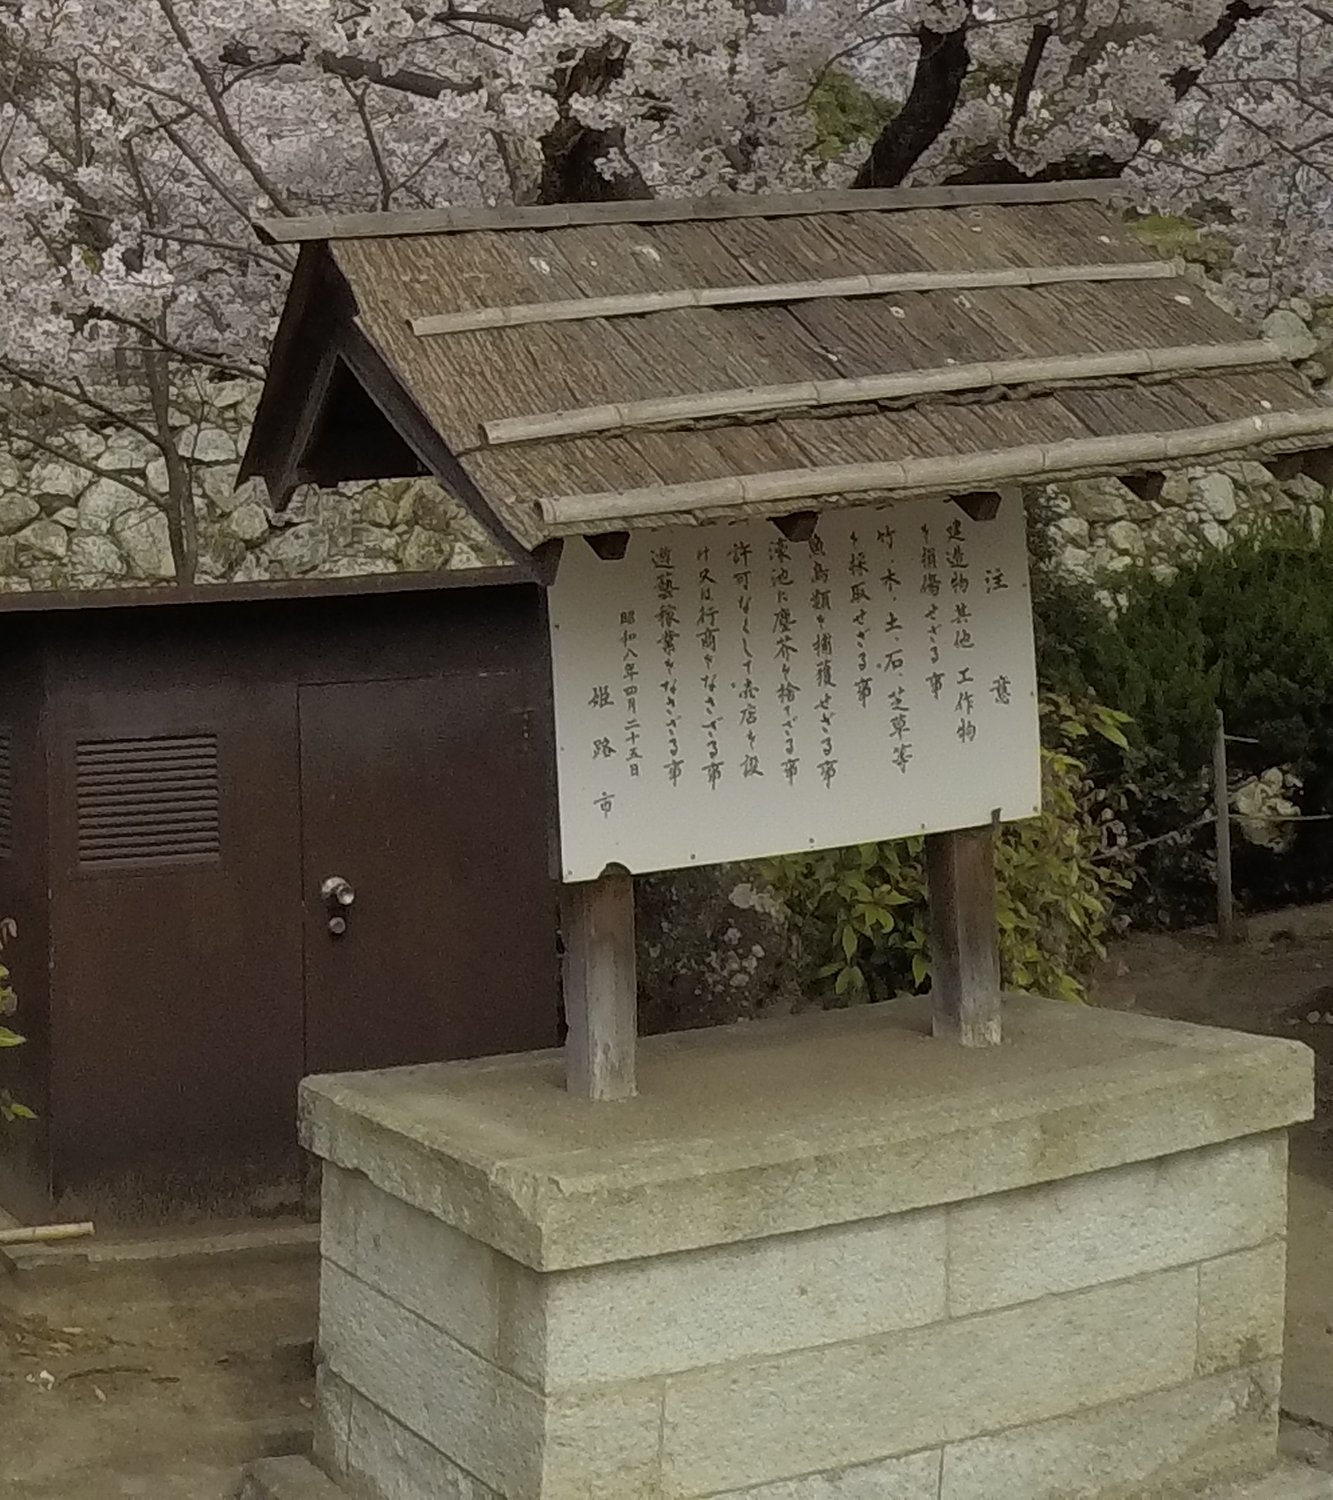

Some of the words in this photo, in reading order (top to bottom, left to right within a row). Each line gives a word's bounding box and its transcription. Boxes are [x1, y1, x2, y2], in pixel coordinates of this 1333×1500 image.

[587, 685, 617, 819] 姫路市
[619, 609, 643, 778] 昭和八年四月二十五日
